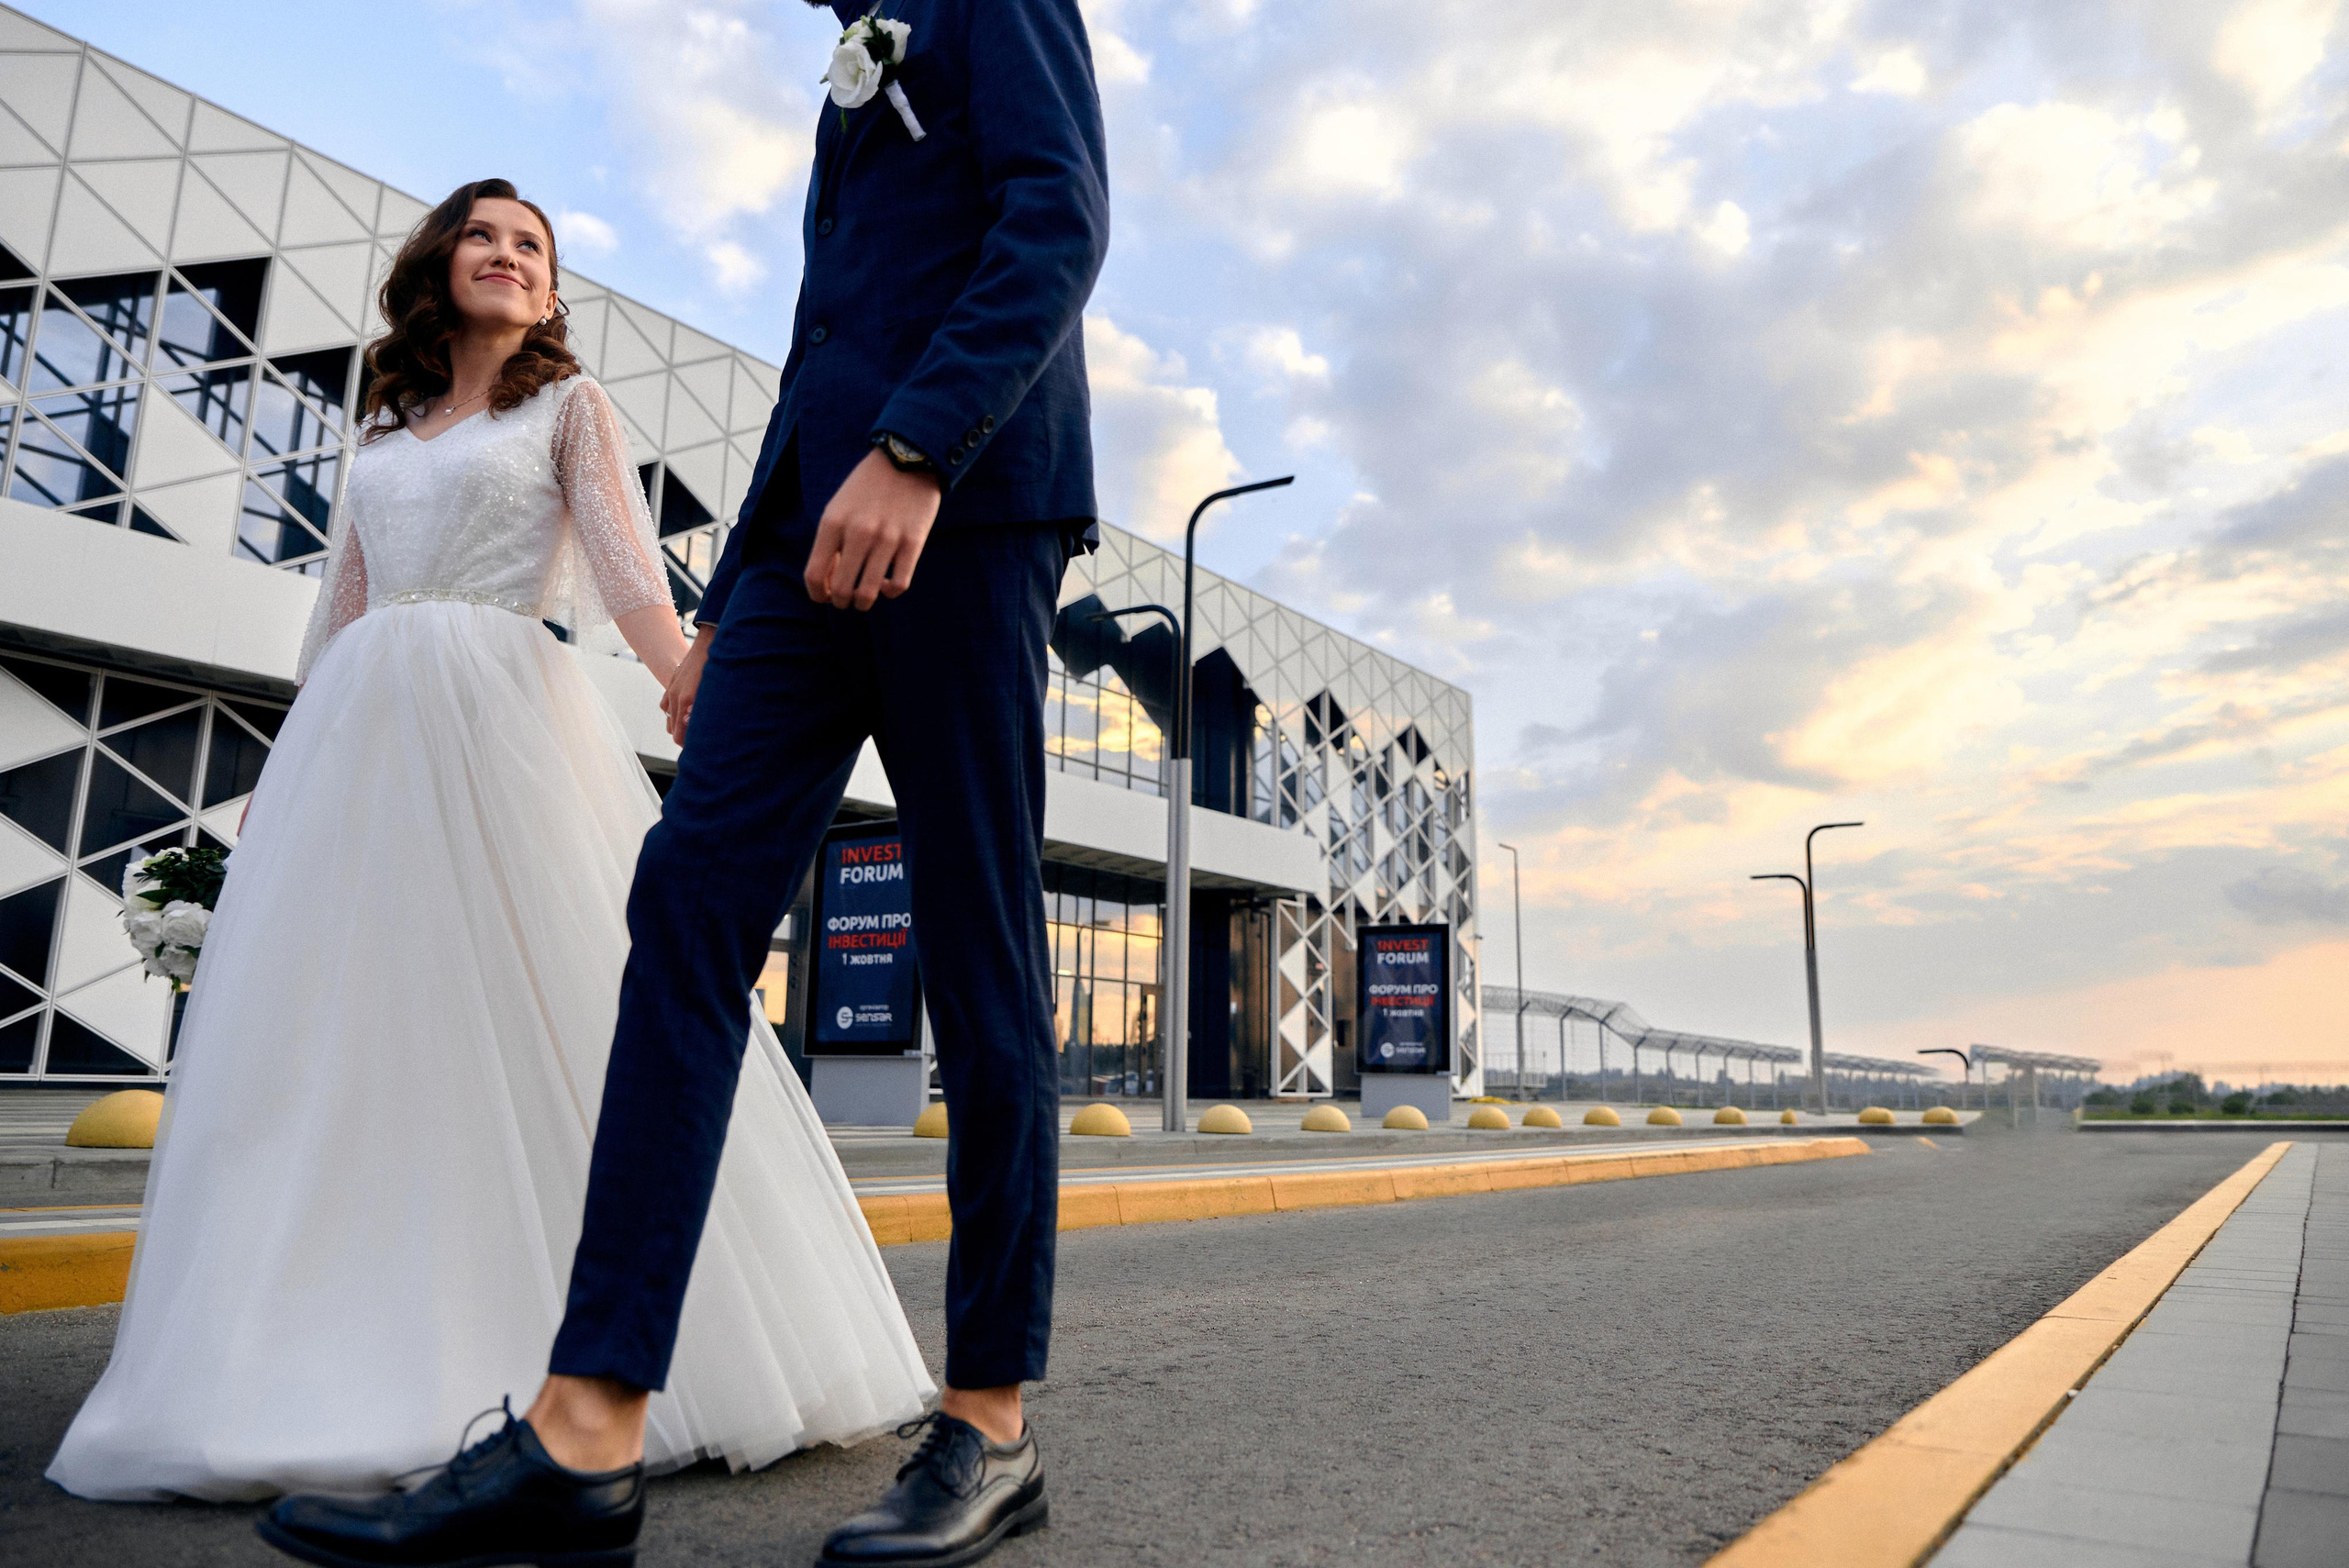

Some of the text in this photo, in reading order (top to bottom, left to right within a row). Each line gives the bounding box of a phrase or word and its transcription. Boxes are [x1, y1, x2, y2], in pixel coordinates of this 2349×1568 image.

[841, 843, 902, 865] INVEST
[840, 862, 904, 884] FORUM
[827, 912, 911, 931] ФОРУМ ПРО
[828, 928, 908, 950] ІНВЕСТИЦІЇ
[1377, 939, 1429, 951] INVEST
[842, 952, 848, 965] 1
[1377, 951, 1429, 964] FORUM
[1369, 984, 1439, 995] ФОРУМ ПРО
